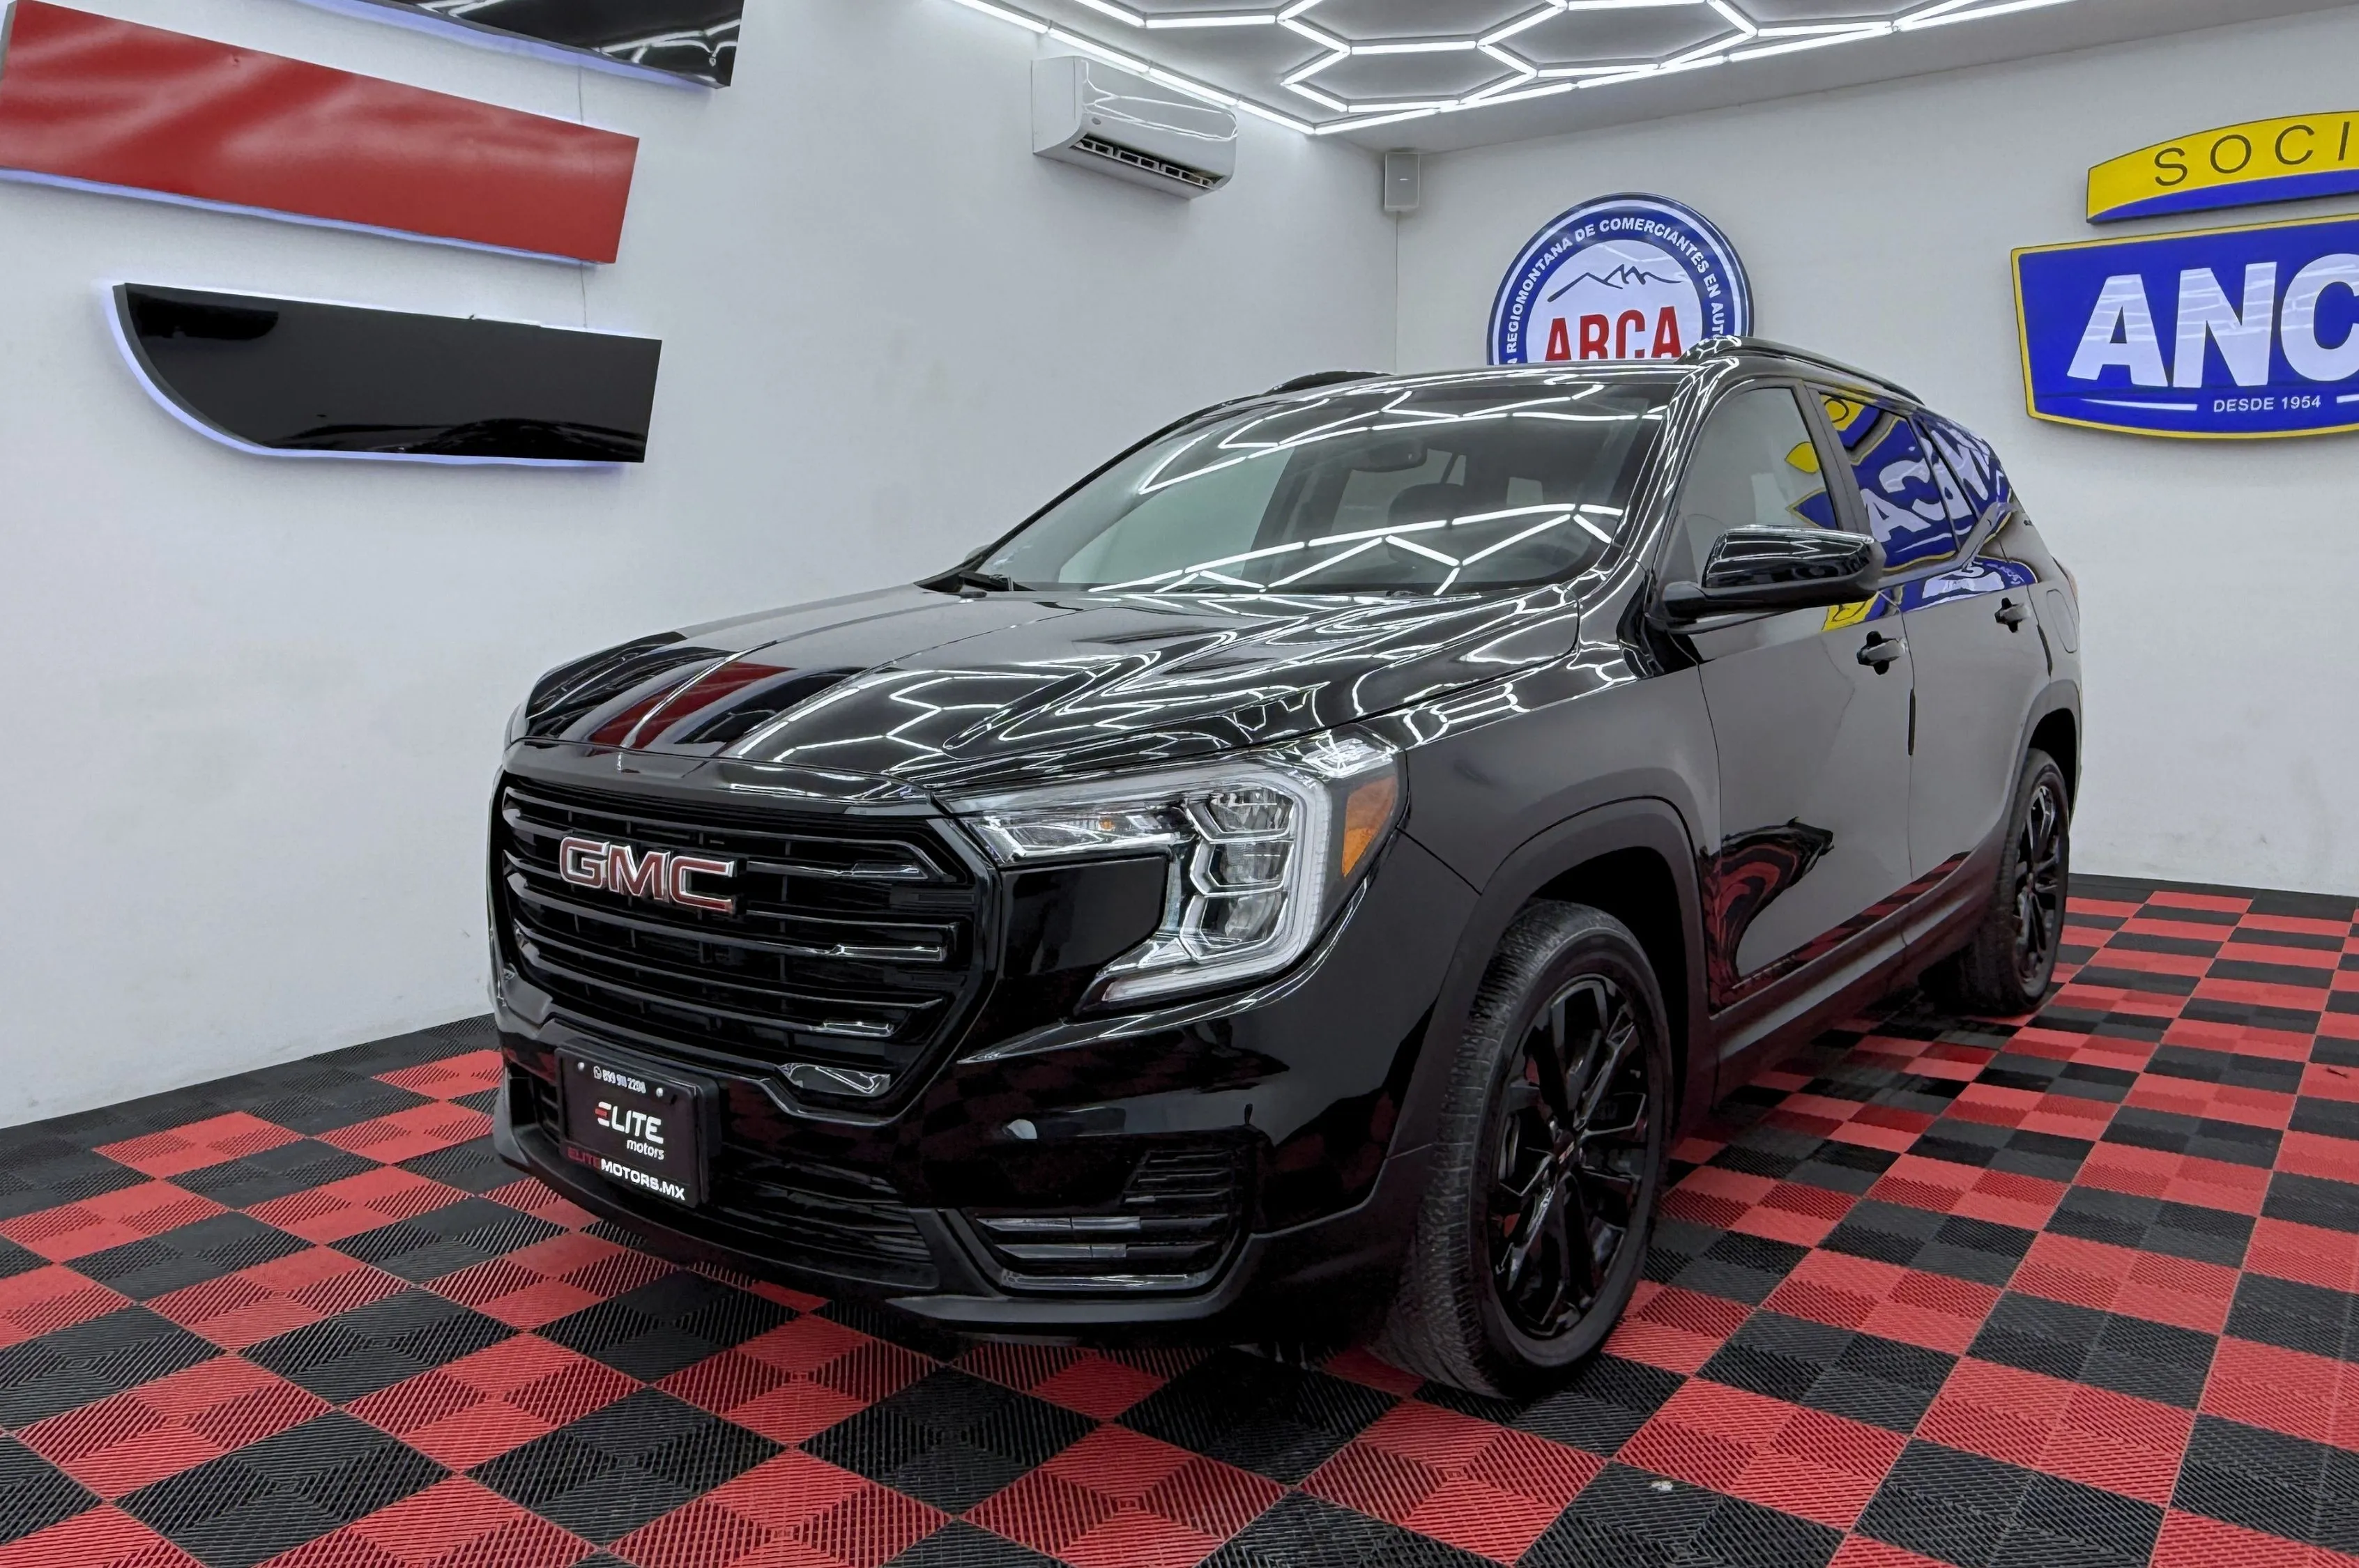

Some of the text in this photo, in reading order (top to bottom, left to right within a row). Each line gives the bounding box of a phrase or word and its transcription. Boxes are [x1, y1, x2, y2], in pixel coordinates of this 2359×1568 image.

[2153, 121, 2351, 187] SOCI
[1506, 217, 1725, 354] REGIOMONTANA DE COMERCIANTES EN AUT
[1544, 305, 1683, 362] ARCA
[2066, 252, 2359, 389] ANC
[2213, 394, 2322, 413] DESDE 1954
[559, 836, 738, 915] GMC
[595, 1101, 664, 1144] ELITE
[626, 1139, 664, 1160] motors
